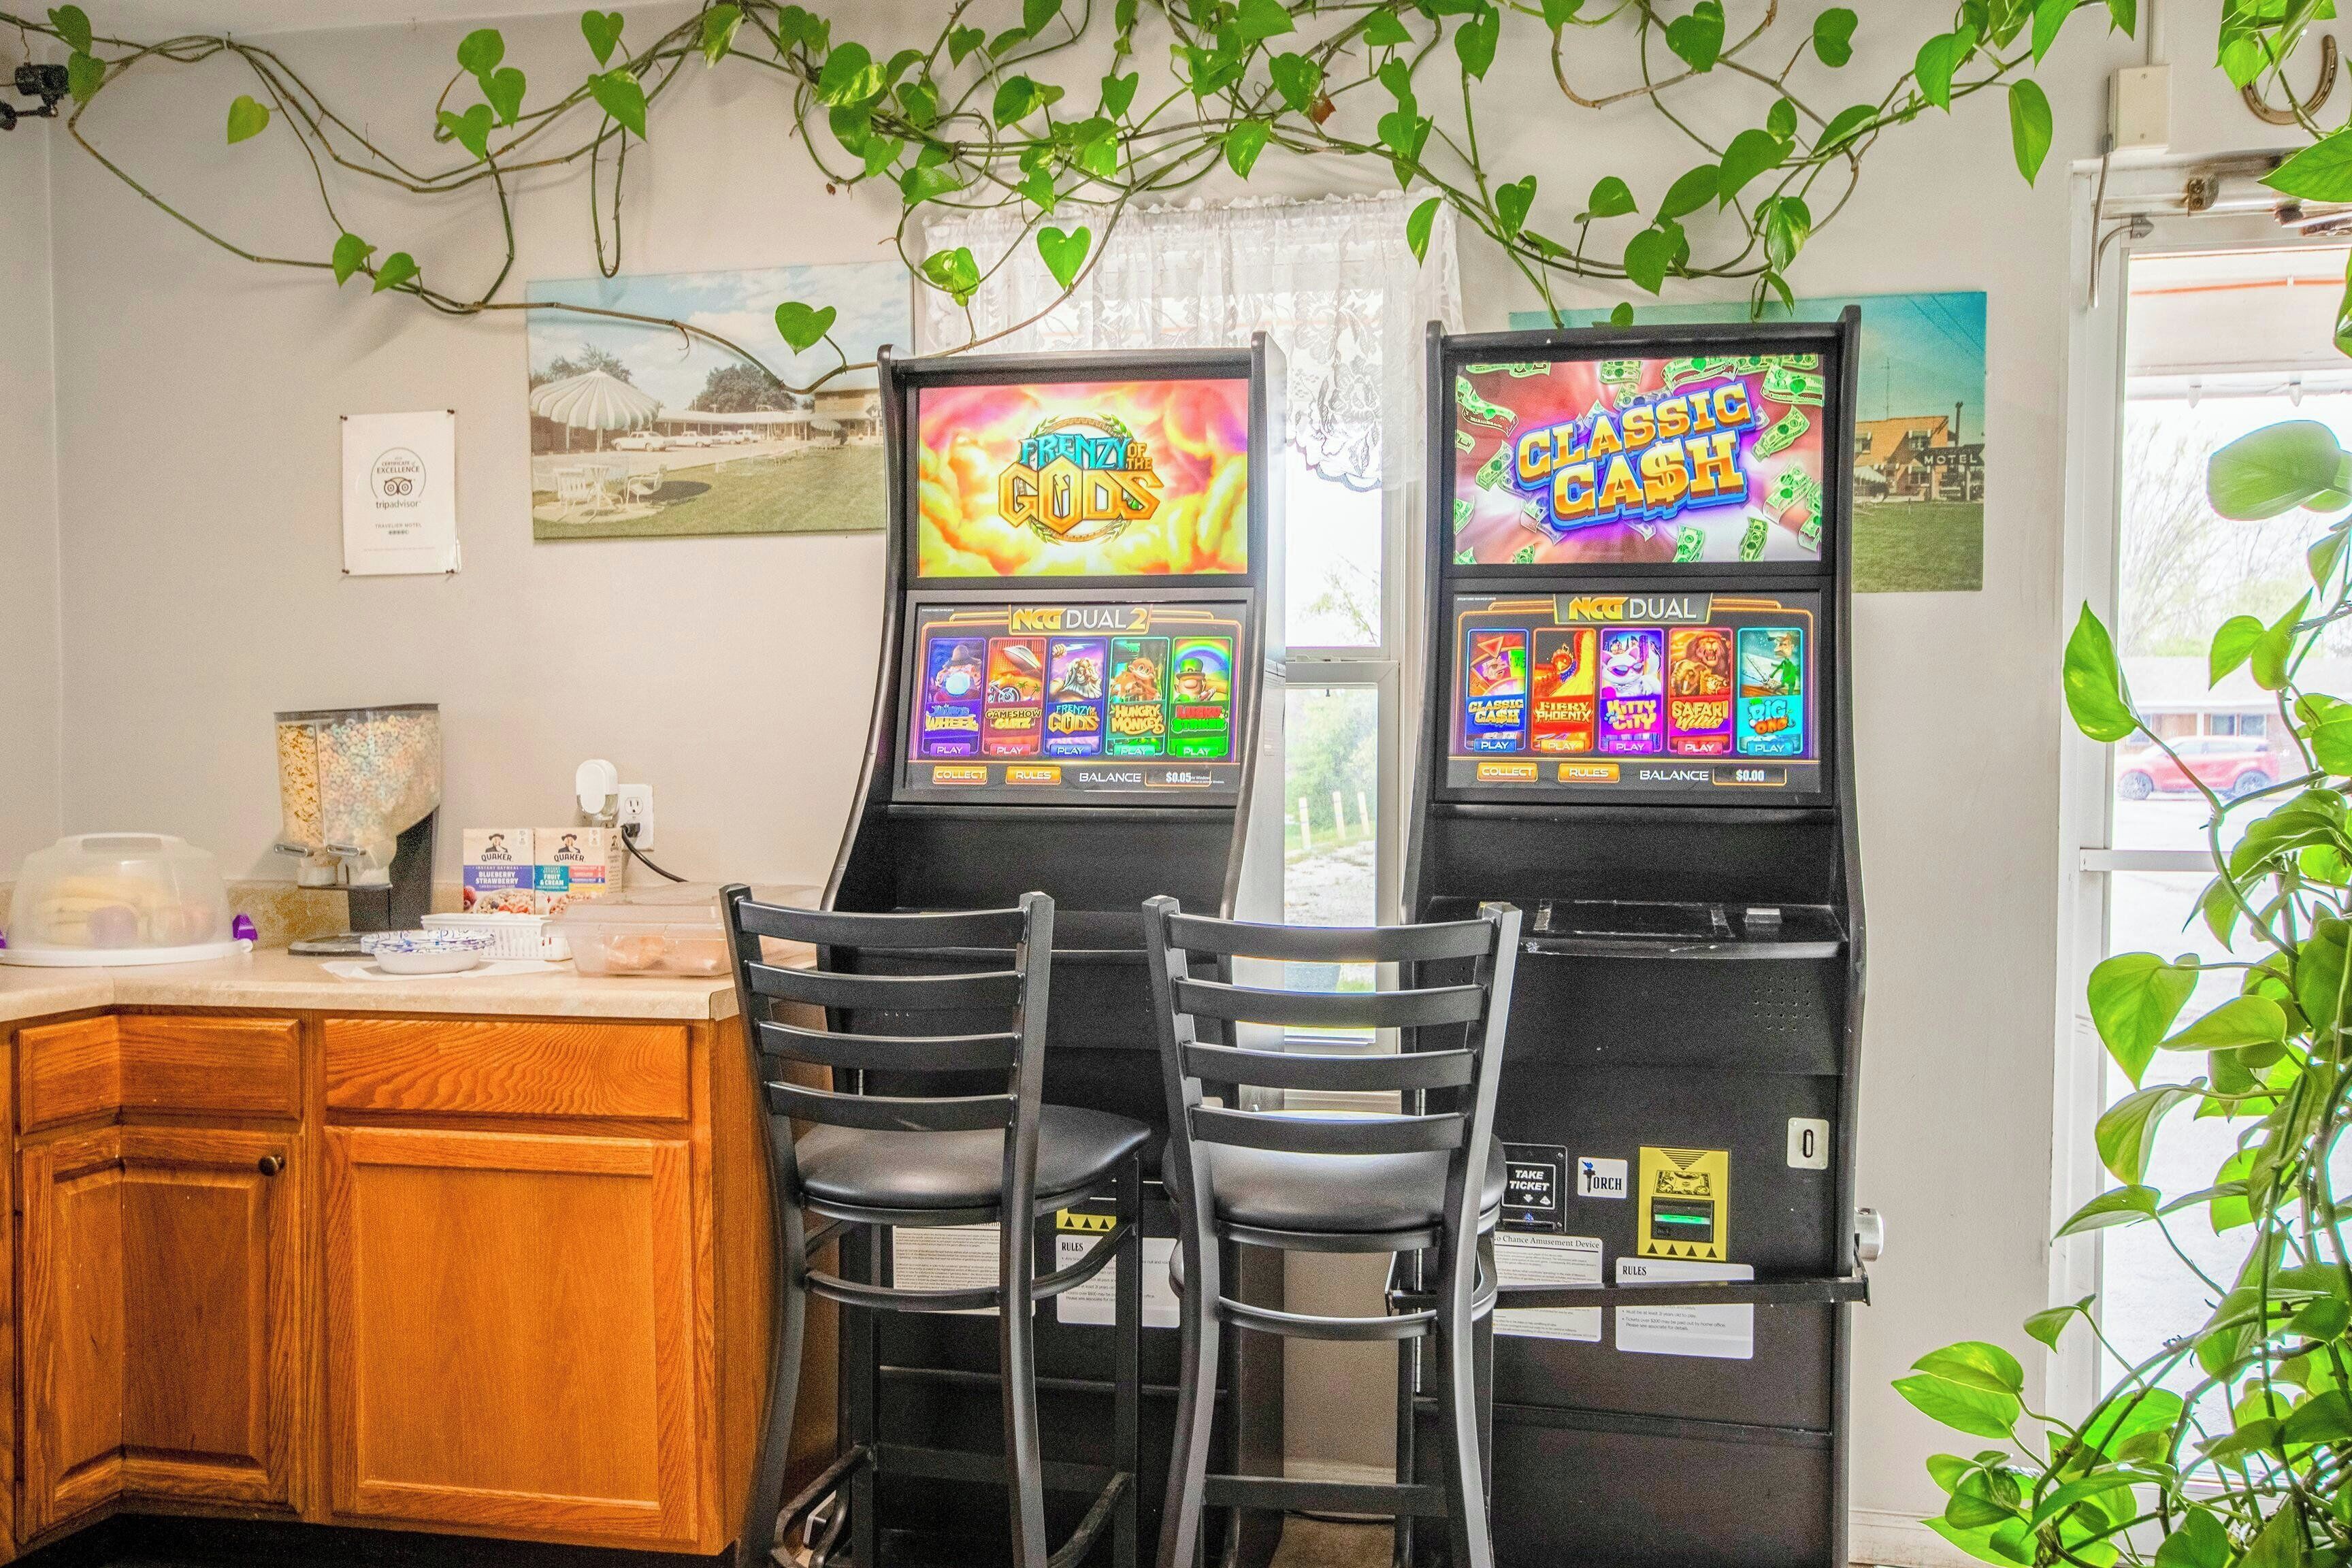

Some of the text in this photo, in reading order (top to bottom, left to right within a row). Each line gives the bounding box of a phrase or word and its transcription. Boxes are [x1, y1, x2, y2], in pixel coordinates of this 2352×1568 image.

[1516, 381, 1754, 485] CLASSIC
[1019, 433, 1147, 470] FRENZY OF
[1126, 457, 1153, 470] THE
[1924, 454, 1977, 464] MOTEL
[998, 455, 1164, 534] GODS
[376, 500, 419, 510] tripadvisor
[1629, 598, 1697, 619] DUAL
[1012, 608, 1149, 631] NCG DUAL 2
[1056, 704, 1092, 715] FRENZY
[1114, 704, 1161, 717] HUNGRY
[1468, 699, 1524, 713] CLASSIC
[1671, 700, 1729, 719] SAFARI
[986, 709, 1042, 719] GAMESHOW
[1534, 709, 1593, 723] PHOENIX
[1048, 712, 1100, 734] GODS
[1548, 742, 1576, 750] PLAY
[1616, 742, 1645, 751] PLAY
[1684, 743, 1715, 752] PLAY
[1755, 744, 1784, 752] PLAY
[1183, 748, 1211, 756] PLAY
[935, 770, 985, 780] COLLECT
[1015, 771, 1052, 780] RULES
[1079, 771, 1192, 783] BALANCE $0.05
[1481, 767, 1533, 777] COLLECT
[1569, 768, 1609, 777] RULES
[1639, 770, 1765, 781] BALANCE $0.00
[481, 853, 512, 862] QUAKER
[554, 853, 585, 862] QUAKER
[1515, 1169, 1544, 1179] TAKE
[1509, 1180, 1550, 1191] TICKET
[1062, 1242, 1084, 1252] RULES
[1502, 1235, 1529, 1244] Chance
[1530, 1237, 1574, 1247] Amusement
[1575, 1241, 1600, 1249] Device
[1622, 1265, 1647, 1276] RULES
